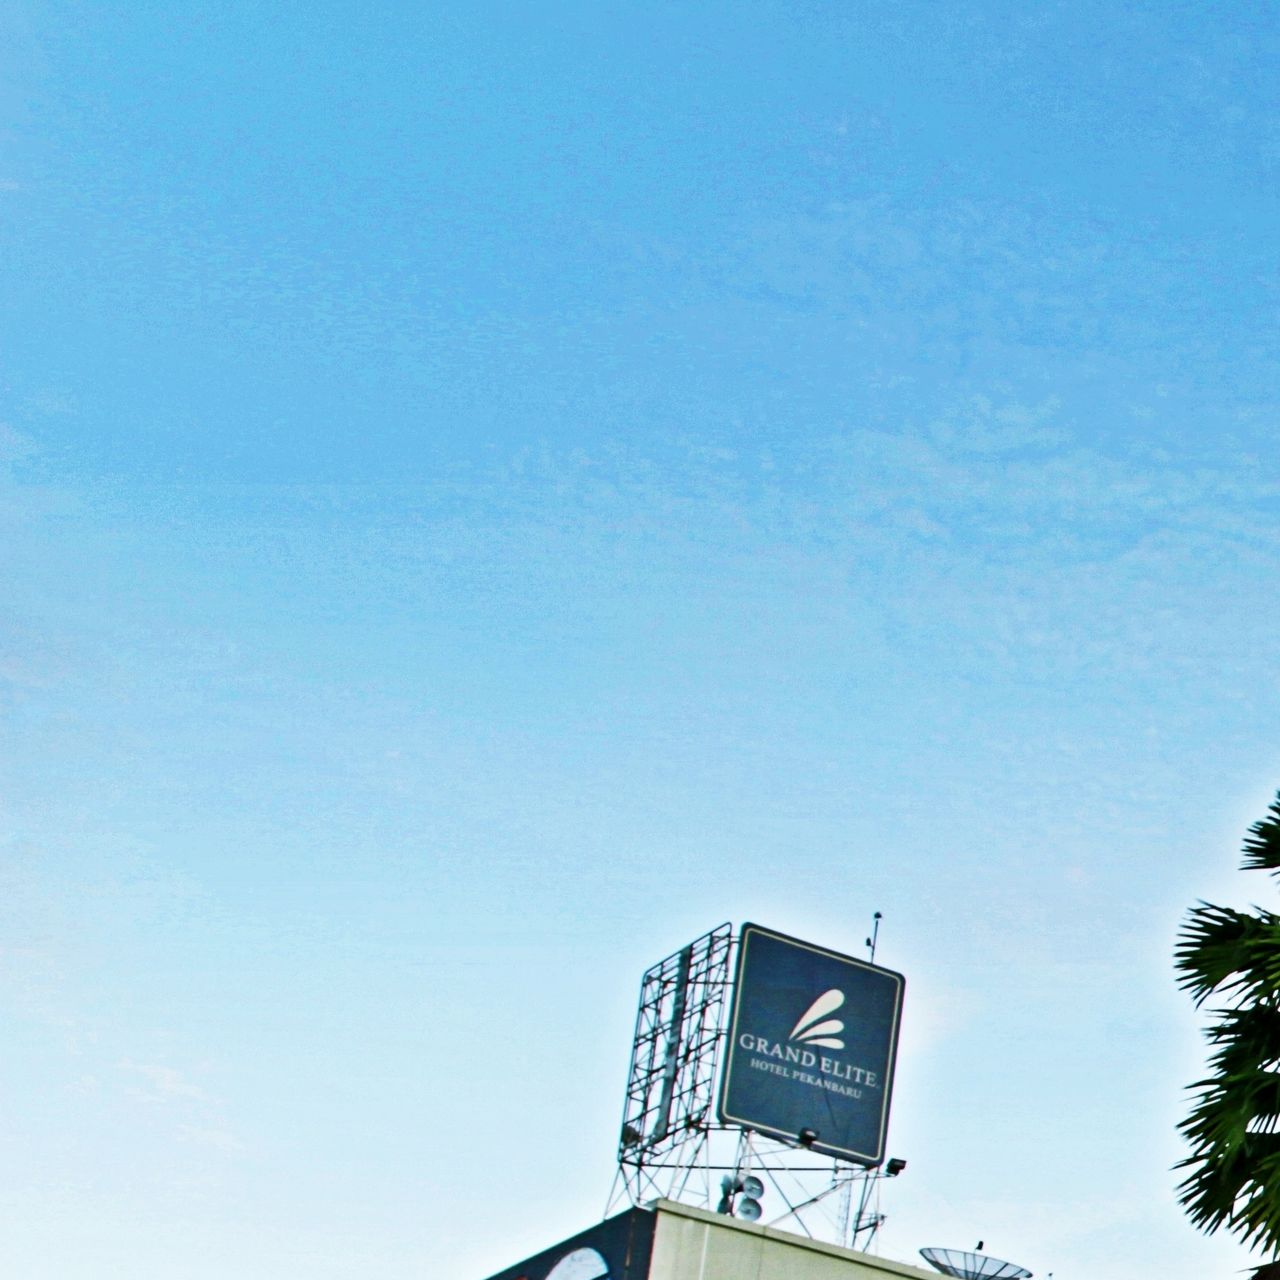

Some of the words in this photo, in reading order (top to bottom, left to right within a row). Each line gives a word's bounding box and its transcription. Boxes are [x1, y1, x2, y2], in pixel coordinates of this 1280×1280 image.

[739, 1033, 816, 1067] GRAND
[820, 1056, 877, 1087] ELITE
[750, 1058, 790, 1078] HOTEL
[792, 1070, 862, 1099] PEKANBARU
